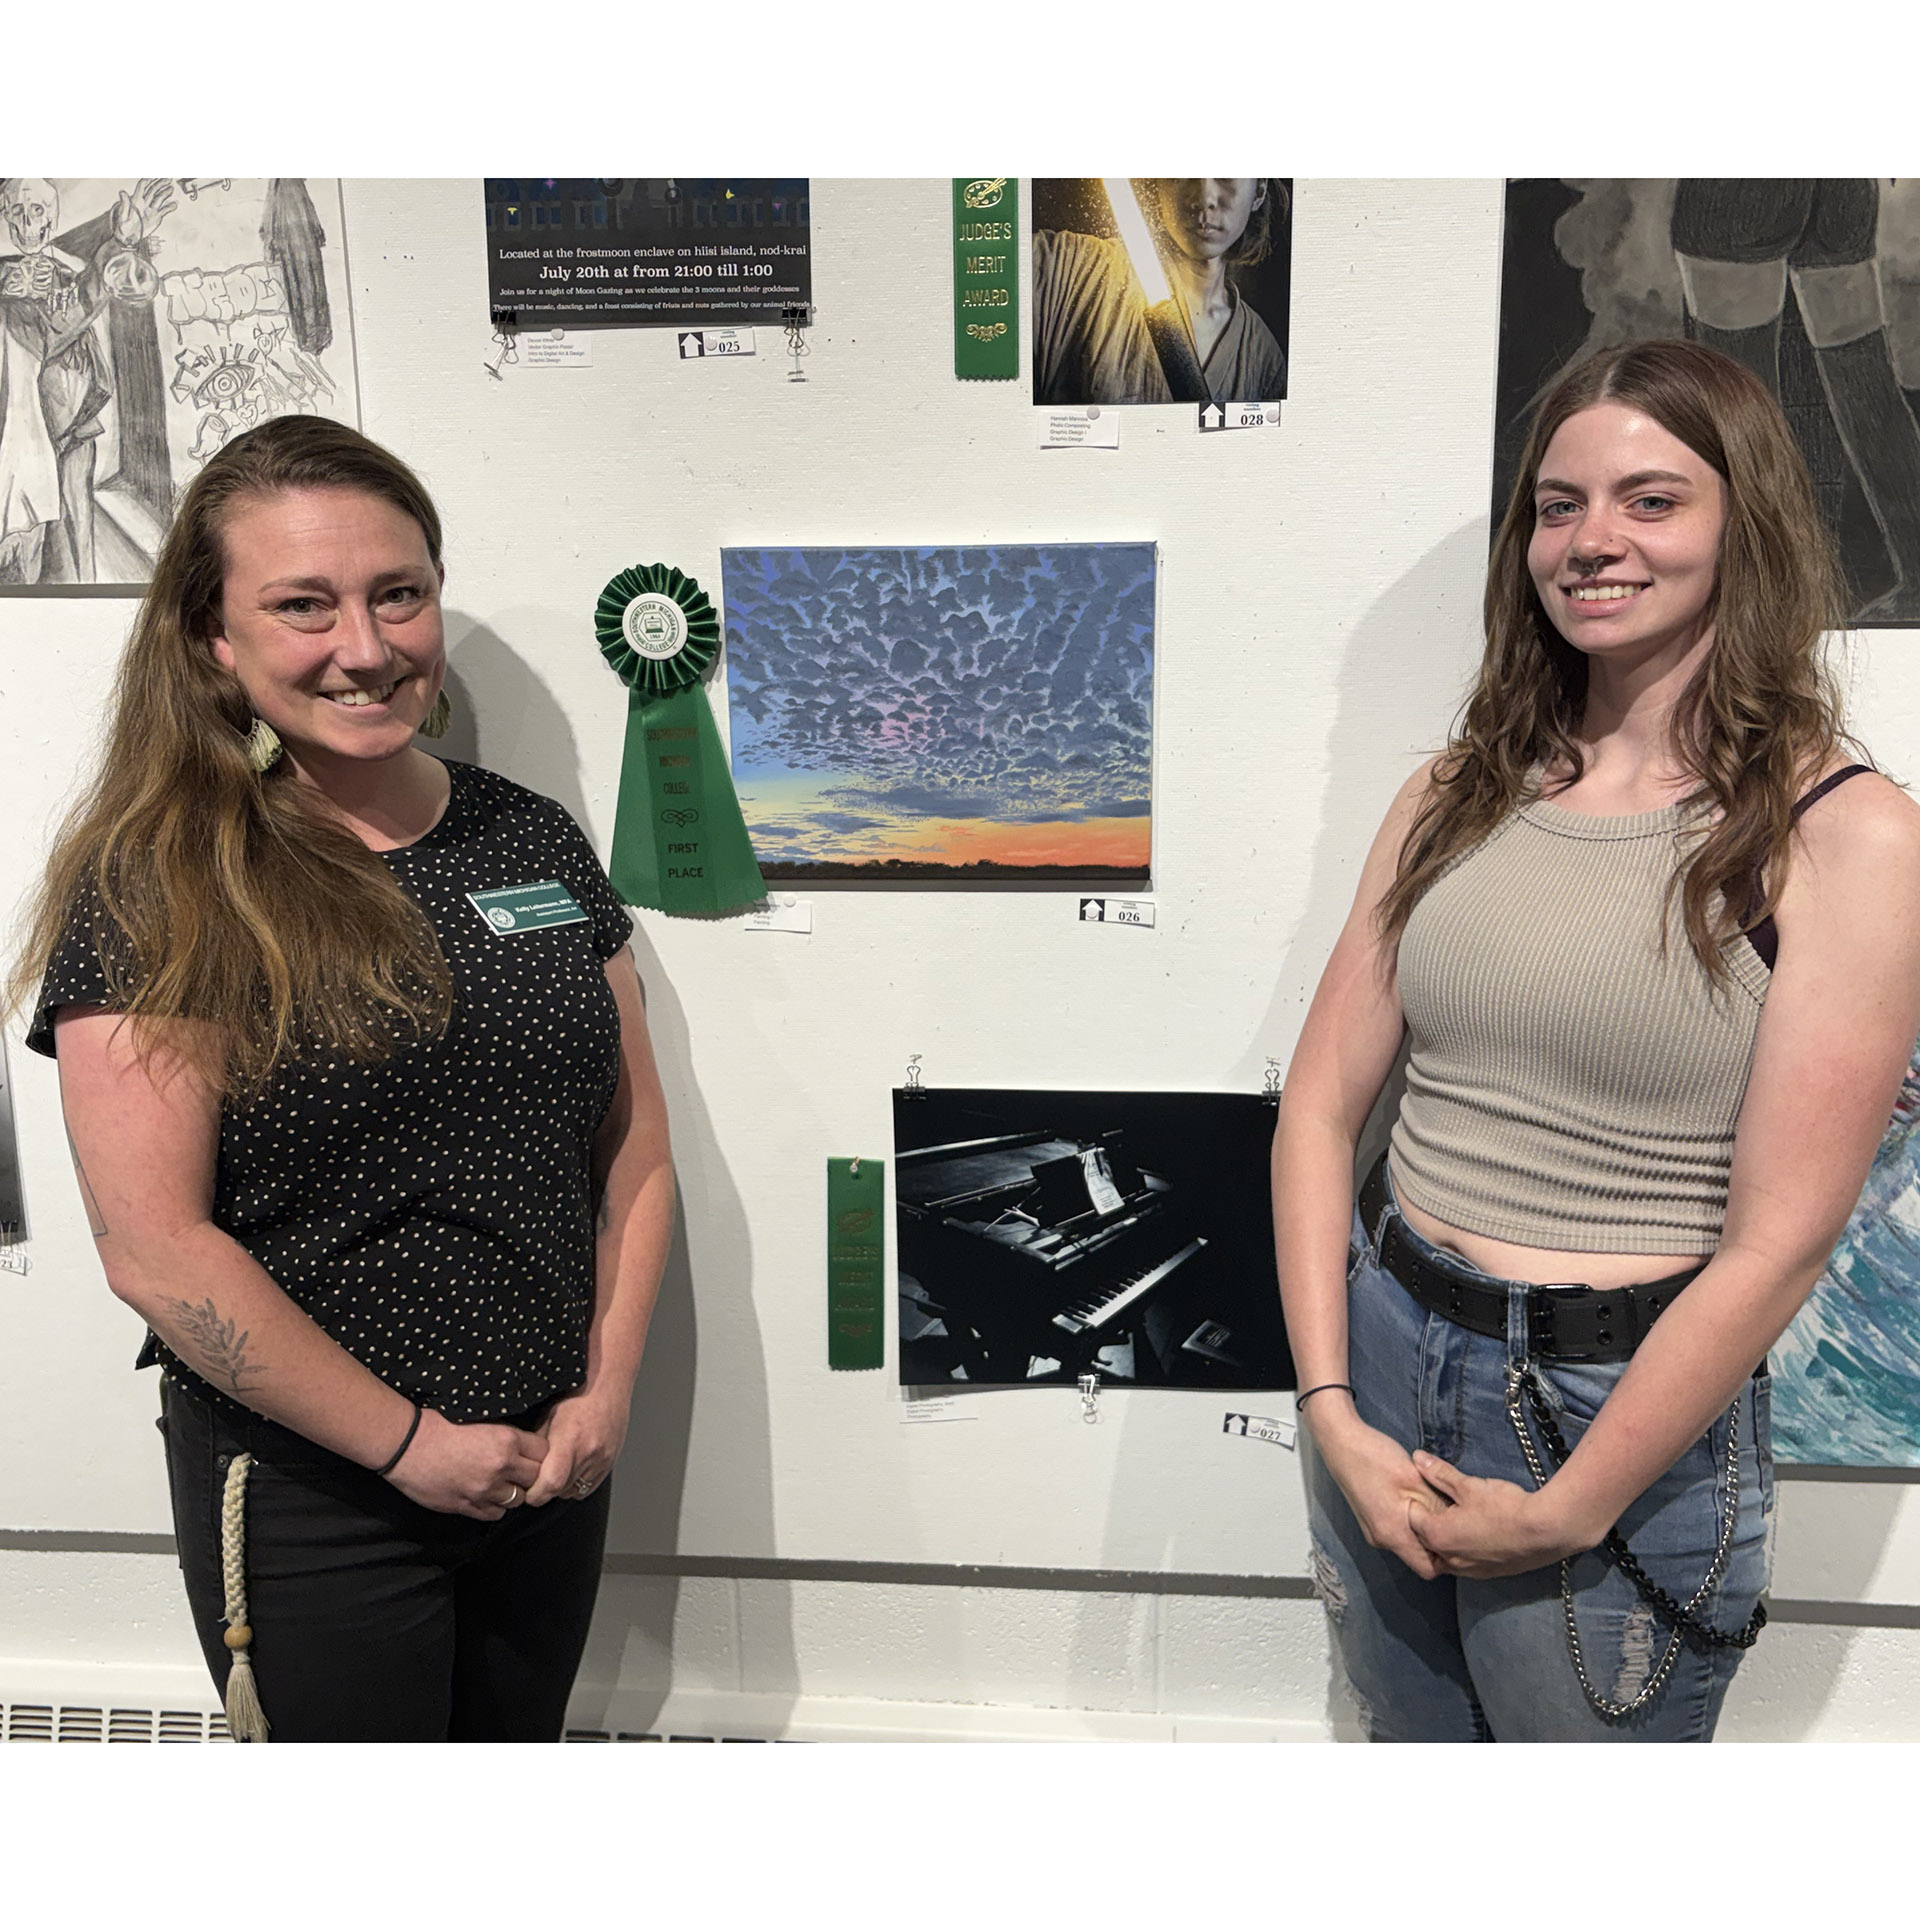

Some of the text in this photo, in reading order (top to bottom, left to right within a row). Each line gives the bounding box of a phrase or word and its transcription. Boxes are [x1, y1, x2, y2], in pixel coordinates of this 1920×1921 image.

[960, 222, 1011, 240] JUDGE'S
[500, 245, 806, 259] Located at the frostmoon enclave on hiisi island, nod-krai
[966, 256, 1005, 274] MERIT
[540, 264, 773, 281] July 20th at from 21:00 till 1:00
[545, 288, 564, 296] night
[597, 287, 623, 295] Gazing
[762, 285, 799, 294] goddesses
[963, 289, 1009, 307] AWARD
[621, 302, 652, 310] consisting
[711, 301, 739, 309] gathered
[741, 301, 749, 309] by
[719, 341, 740, 353] 025
[1241, 414, 1263, 425] 028
[668, 843, 698, 853] FIRST
[668, 867, 703, 878] PLACE
[1119, 911, 1140, 922] 026
[1260, 1428, 1281, 1440] 027
